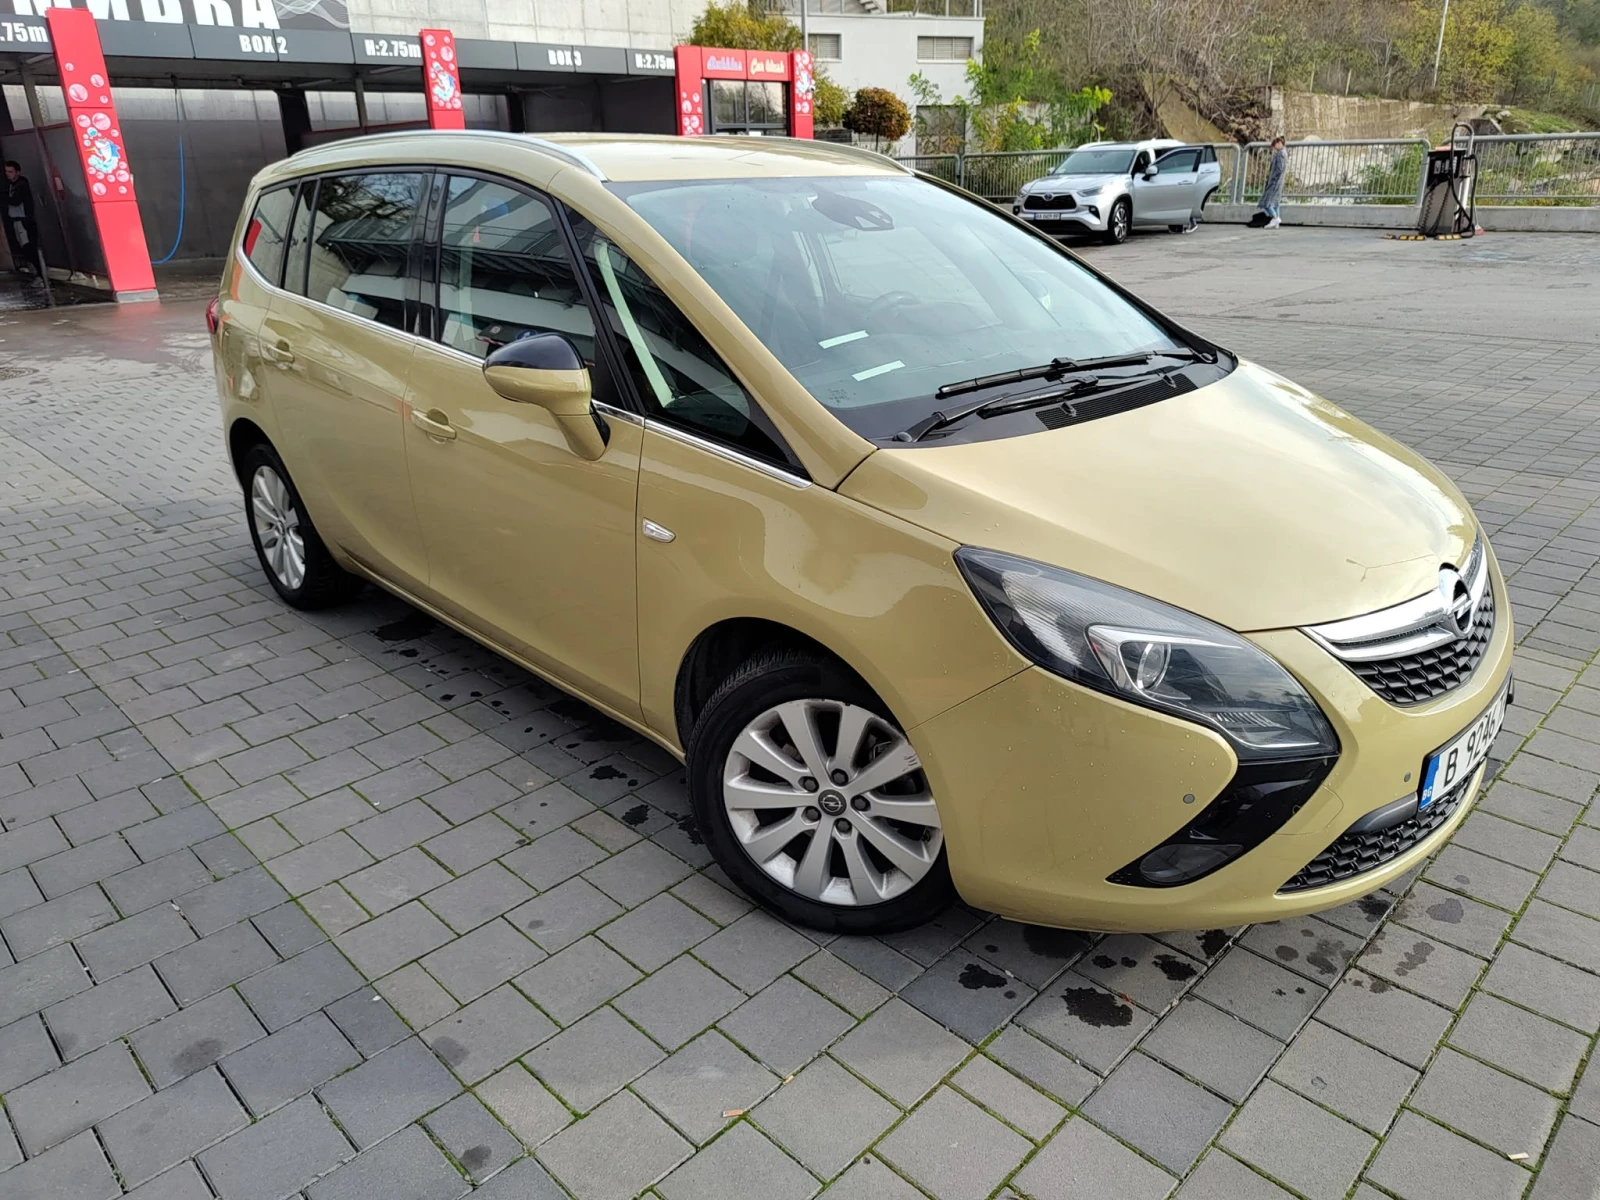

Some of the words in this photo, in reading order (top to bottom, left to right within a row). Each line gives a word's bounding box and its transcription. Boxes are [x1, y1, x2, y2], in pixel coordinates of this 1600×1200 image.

[239, 34, 275, 53] BOX
[276, 36, 288, 54] 2
[364, 39, 422, 58] H:2.75m
[547, 50, 573, 66] BOX
[573, 51, 583, 66] 3
[750, 57, 765, 75] Car
[1443, 747, 1459, 788] B
[1467, 703, 1497, 768] 9246
[1422, 786, 1433, 799] BG
